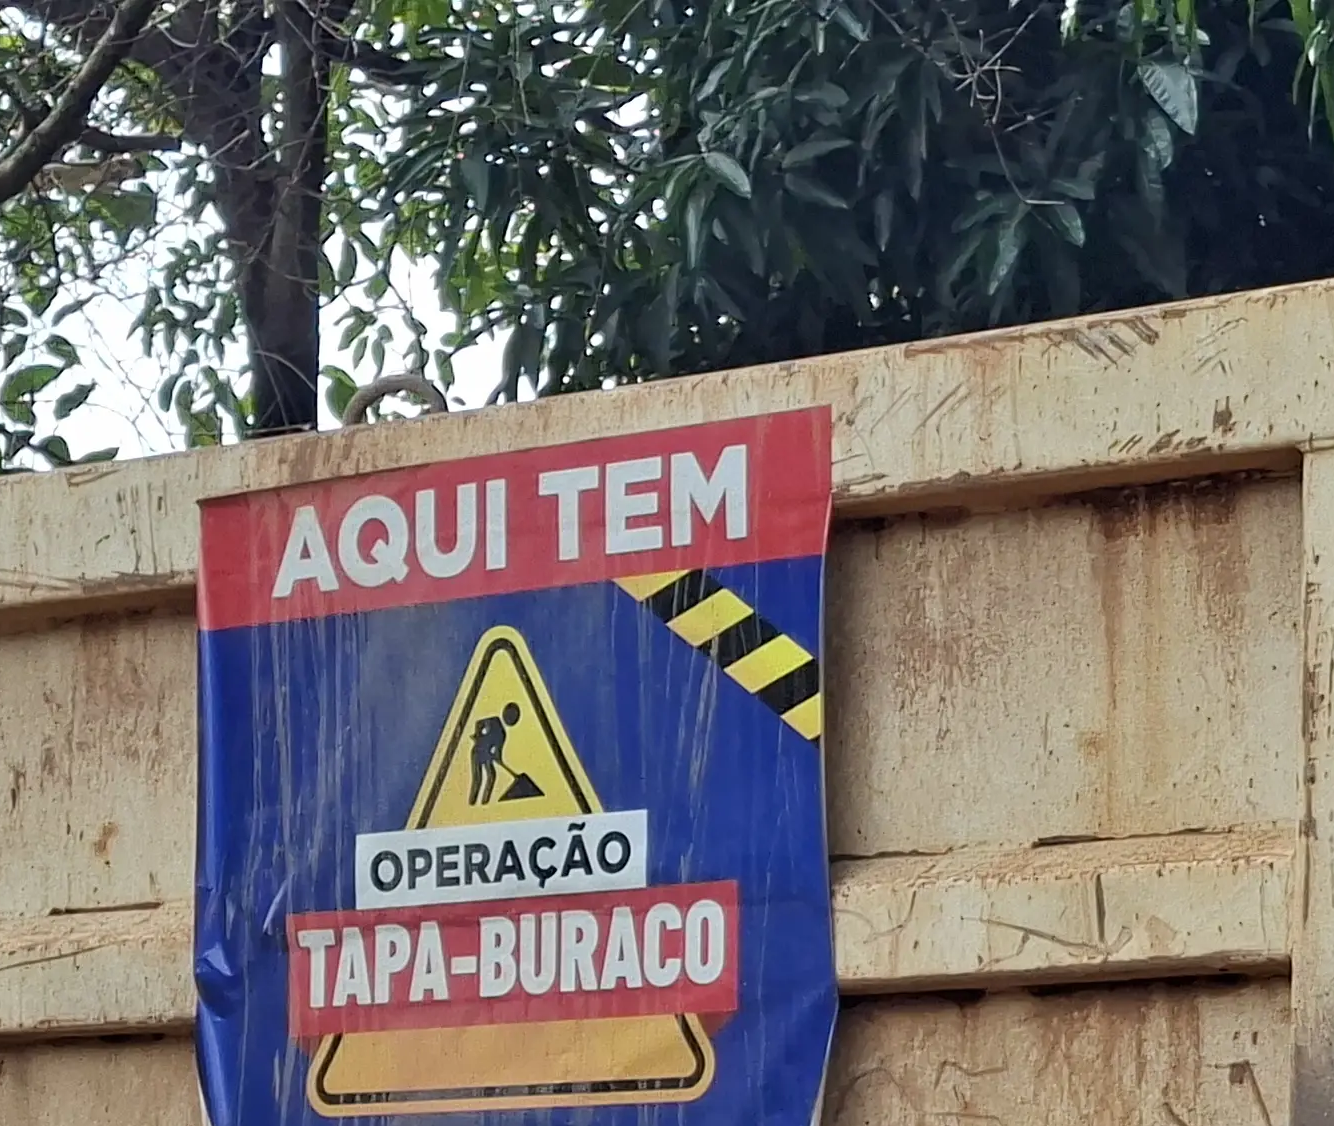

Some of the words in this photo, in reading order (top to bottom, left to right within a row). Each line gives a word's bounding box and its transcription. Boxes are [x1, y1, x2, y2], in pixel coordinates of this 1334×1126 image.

[271, 477, 508, 599] AQUI
[538, 444, 749, 561] TEM
[369, 822, 632, 891] OPERAÇÃO
[297, 898, 726, 1009] TAPA-BURACO
